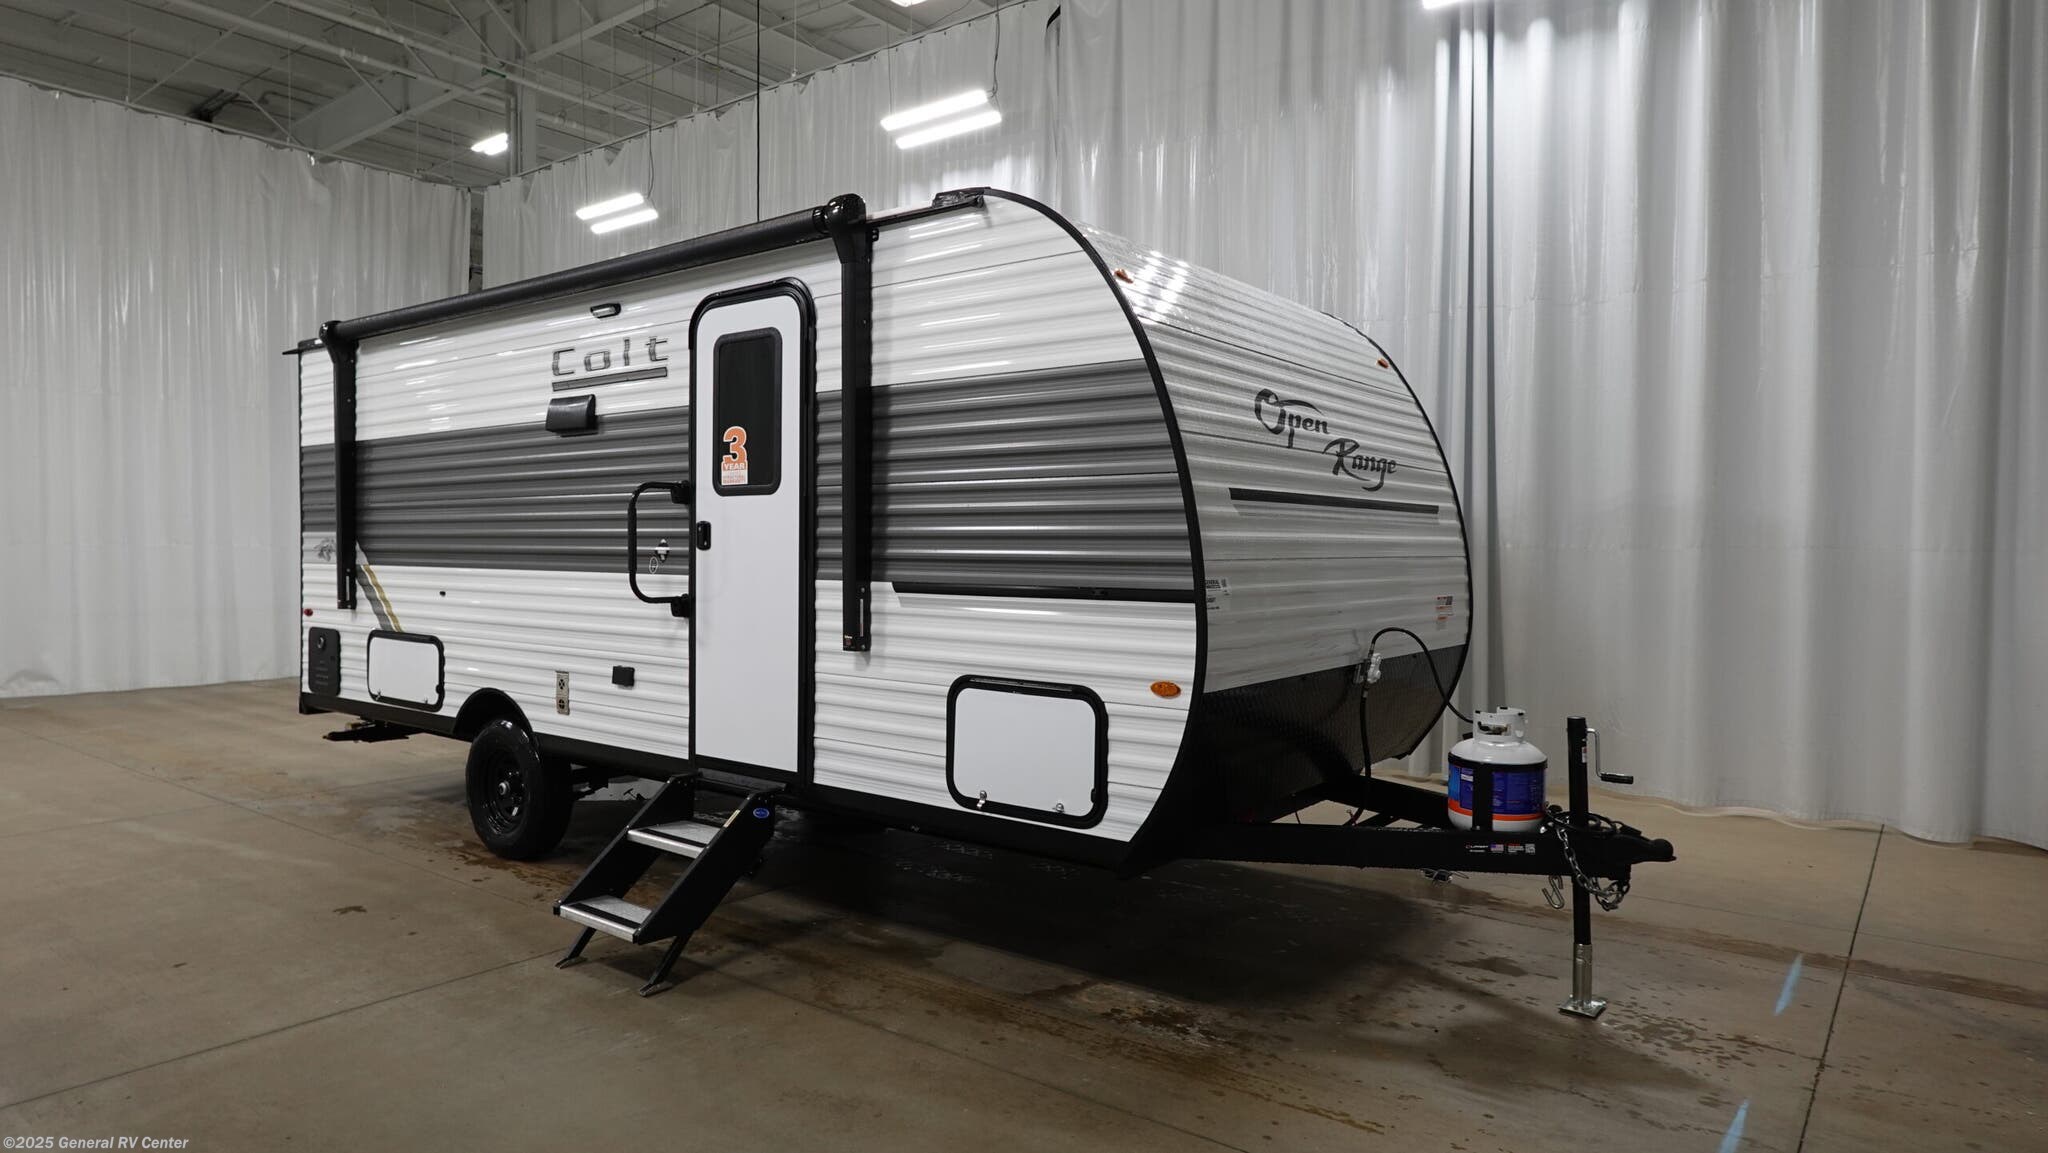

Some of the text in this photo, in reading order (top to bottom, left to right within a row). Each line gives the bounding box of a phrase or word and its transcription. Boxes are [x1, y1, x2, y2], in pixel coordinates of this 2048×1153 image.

[552, 337, 668, 376] Colt
[1254, 388, 1330, 449] Open
[723, 426, 747, 463] 3
[723, 462, 746, 471] YEAR
[1322, 438, 1398, 492] Range
